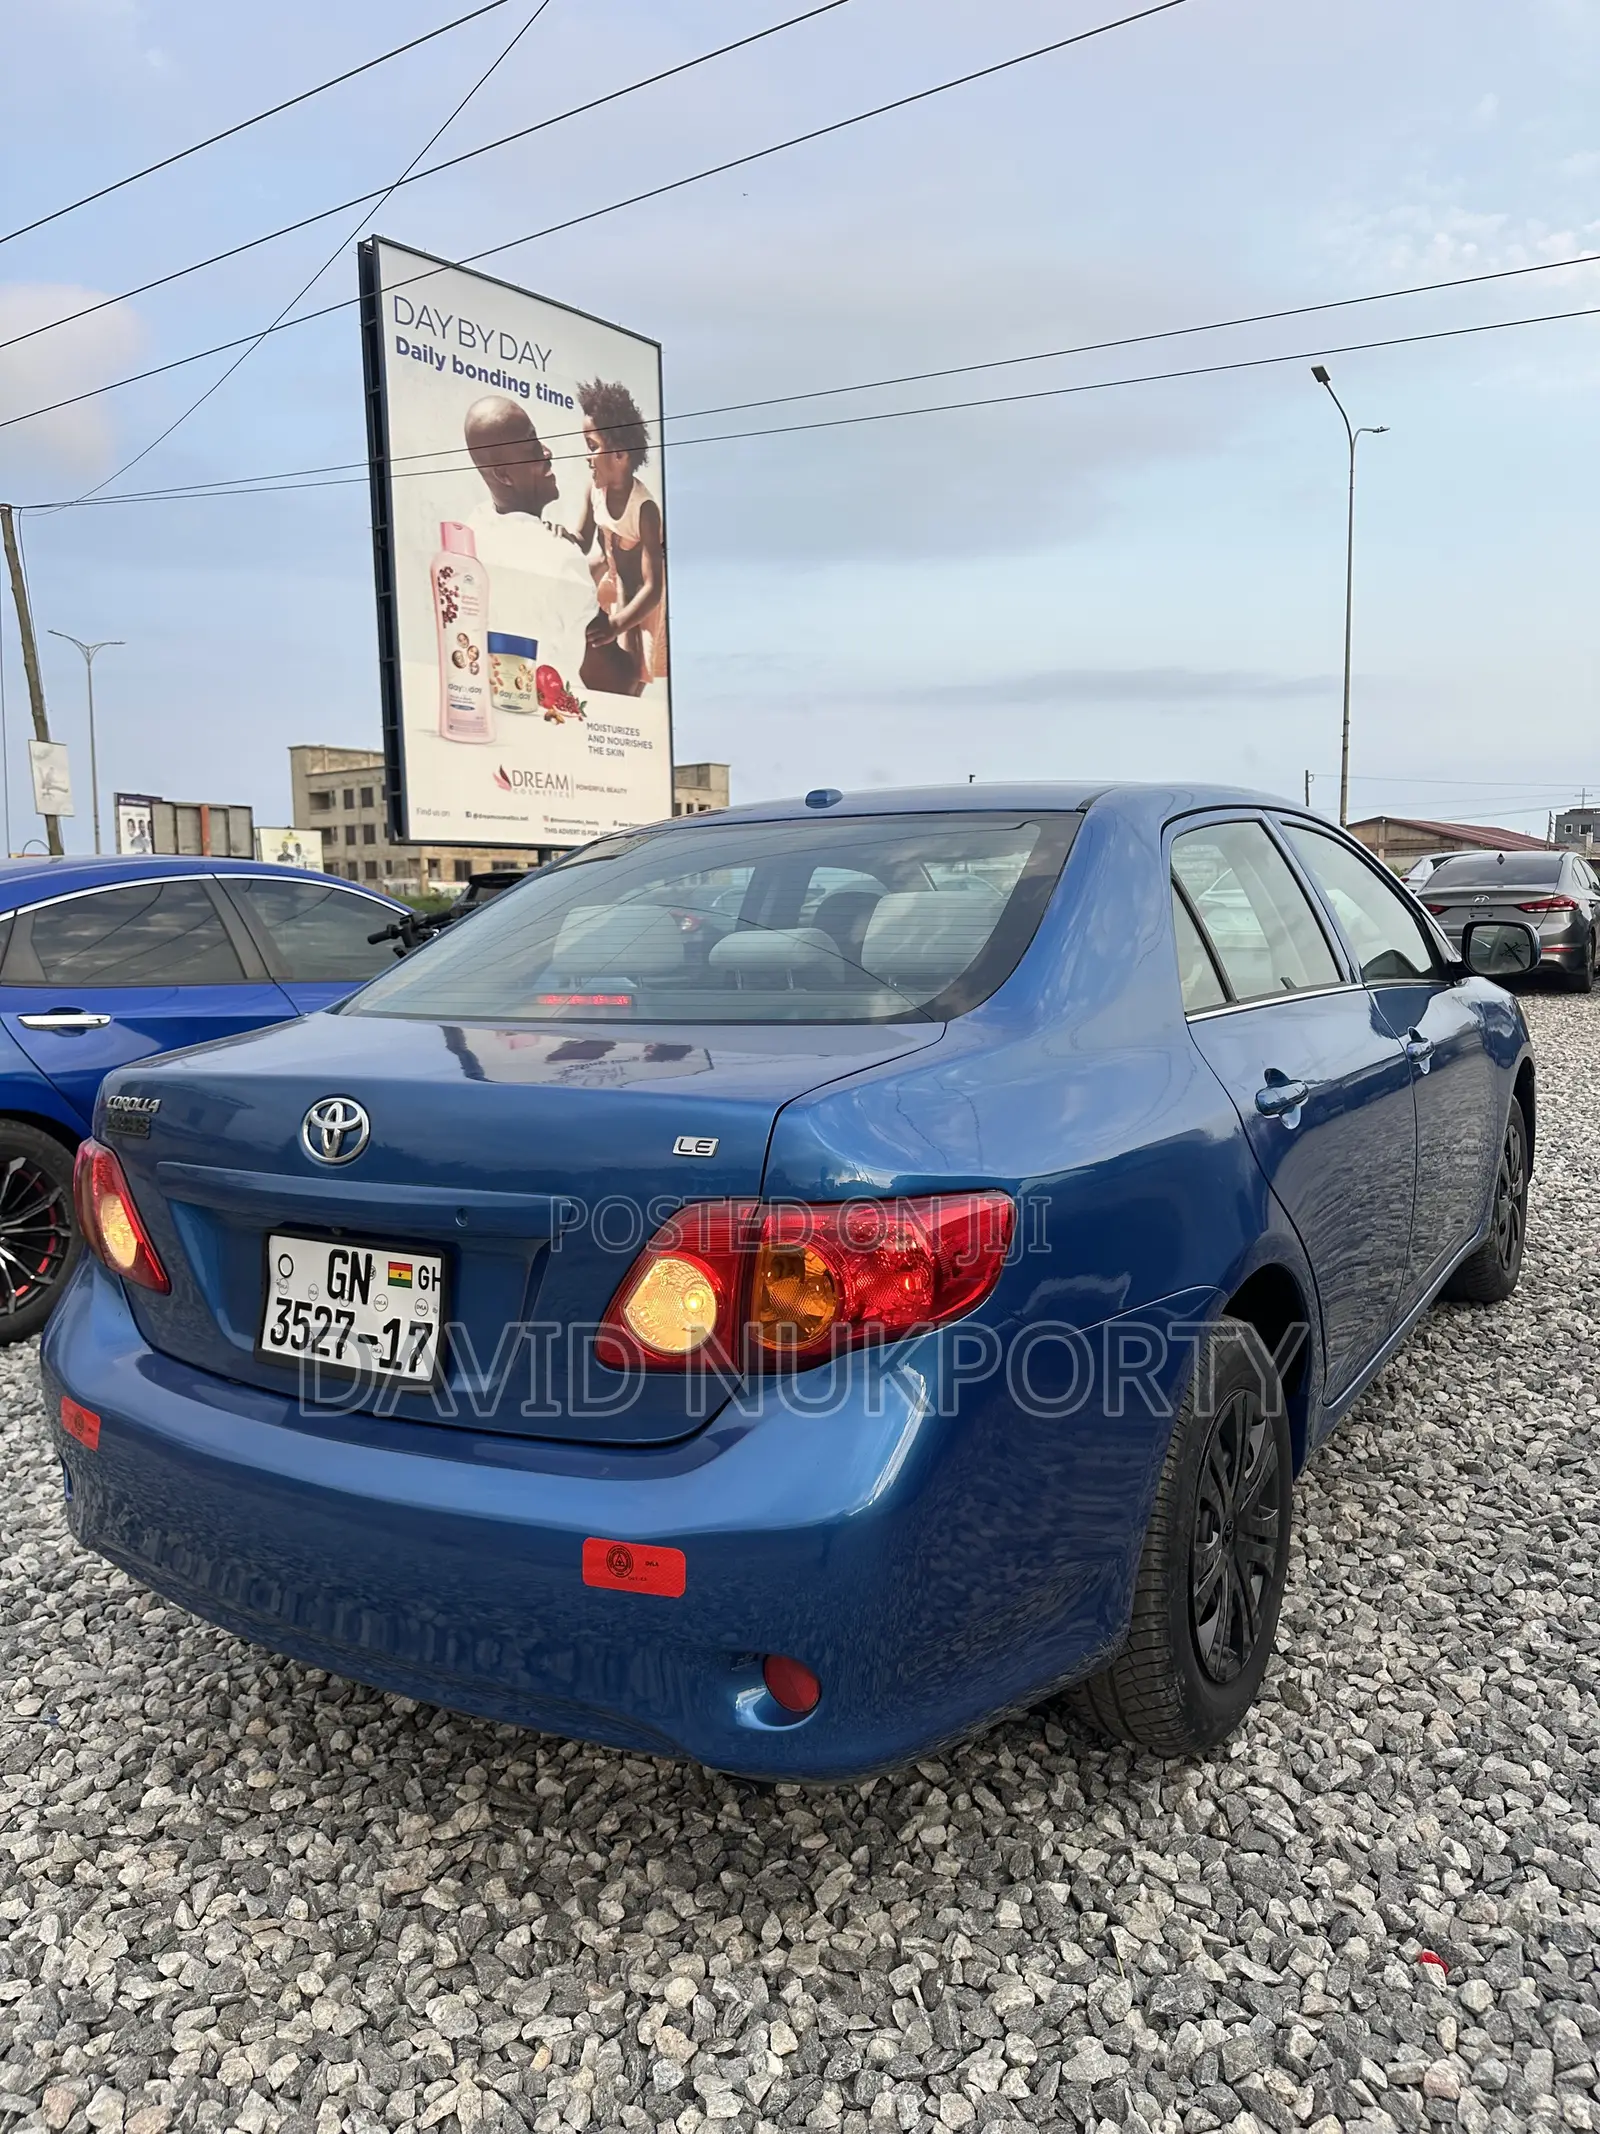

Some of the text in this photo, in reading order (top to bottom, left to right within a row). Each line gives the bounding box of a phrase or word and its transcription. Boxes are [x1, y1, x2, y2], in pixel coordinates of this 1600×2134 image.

[393, 295, 552, 373] DAY BY DAY
[395, 335, 575, 410] Daily bonding time
[448, 683, 482, 694] dayday
[586, 722, 640, 737] MOISTURIZES
[587, 734, 653, 749] AND NOURISHES
[588, 745, 625, 757] THE SKIN
[512, 769, 569, 791] DREAM
[513, 788, 570, 799] COSMETICS
[575, 783, 628, 795] POWERFUL BEAUTY
[558, 827, 580, 835] ADVERT
[106, 1095, 161, 1113] COROLLA
[678, 1138, 714, 1154] LE
[327, 1249, 373, 1305] GN
[270, 1297, 433, 1373] 3527-17
